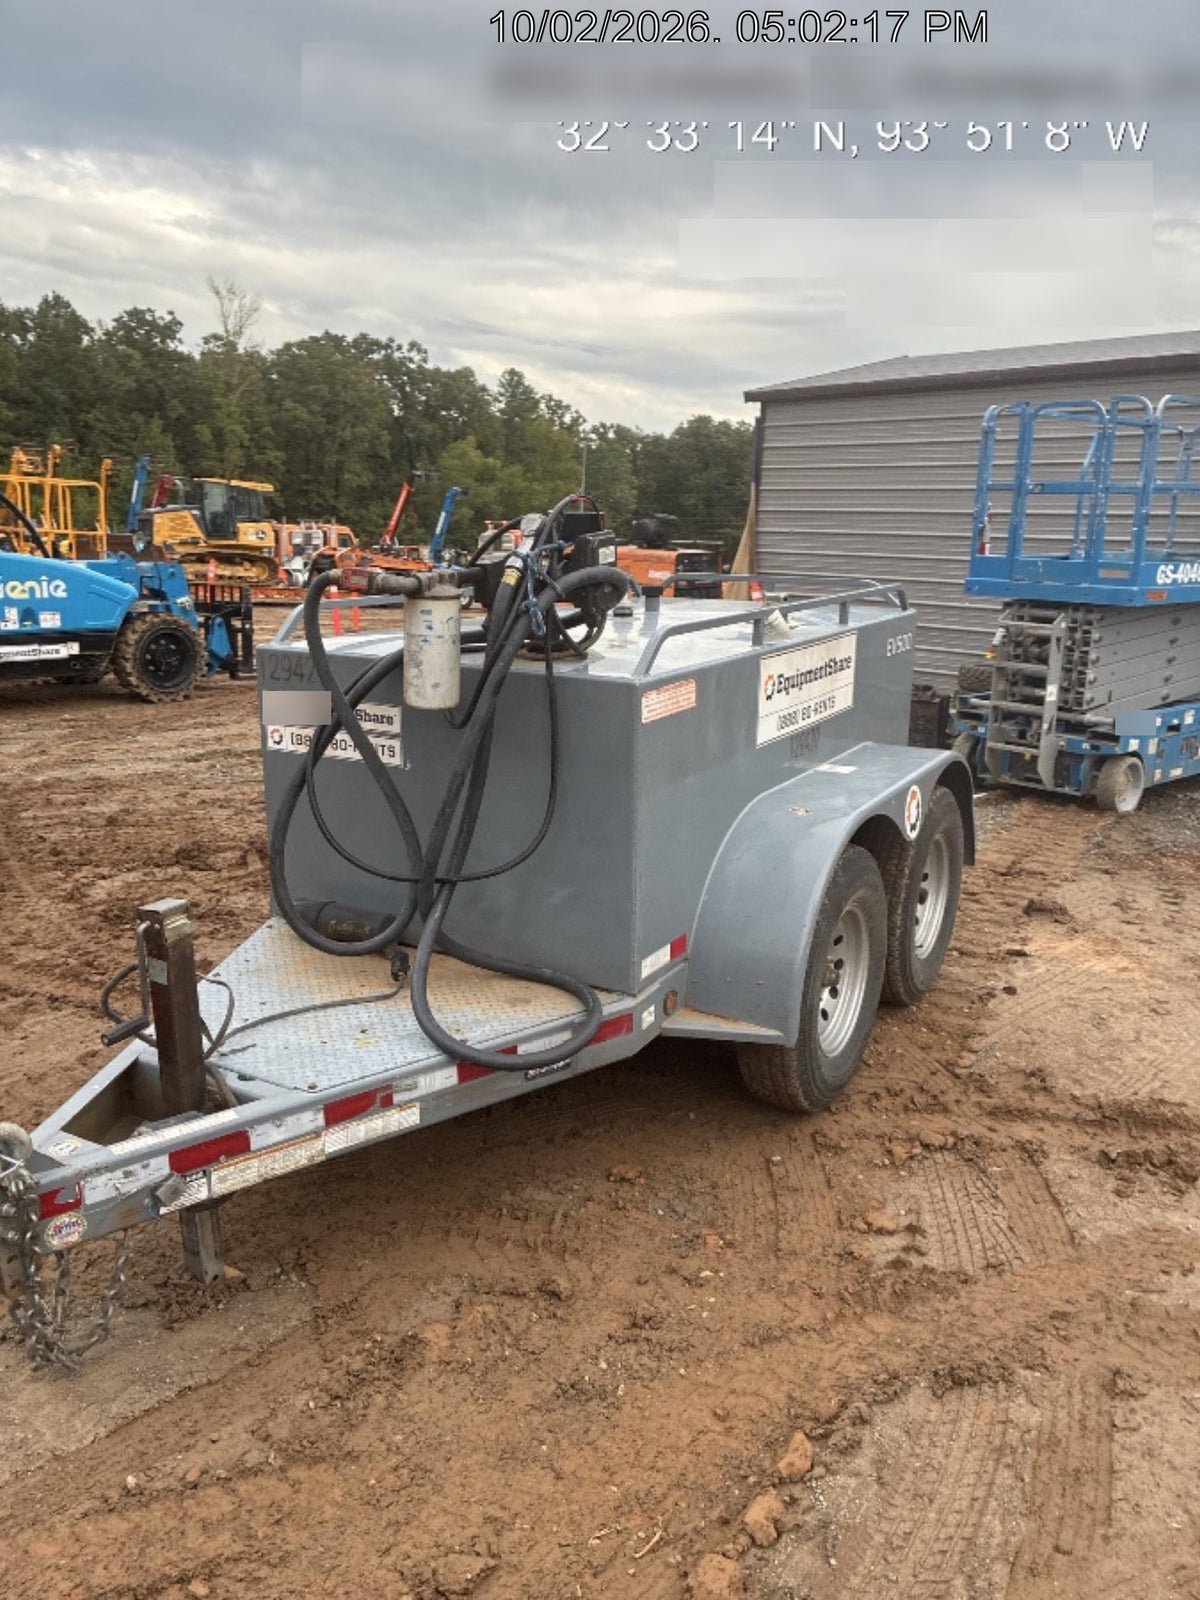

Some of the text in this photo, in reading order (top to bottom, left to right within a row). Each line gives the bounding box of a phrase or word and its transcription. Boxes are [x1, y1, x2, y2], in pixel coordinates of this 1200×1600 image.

[1156, 563, 1200, 585] GS-404
[0, 575, 68, 599] enie
[776, 655, 852, 696] EquipmentShare
